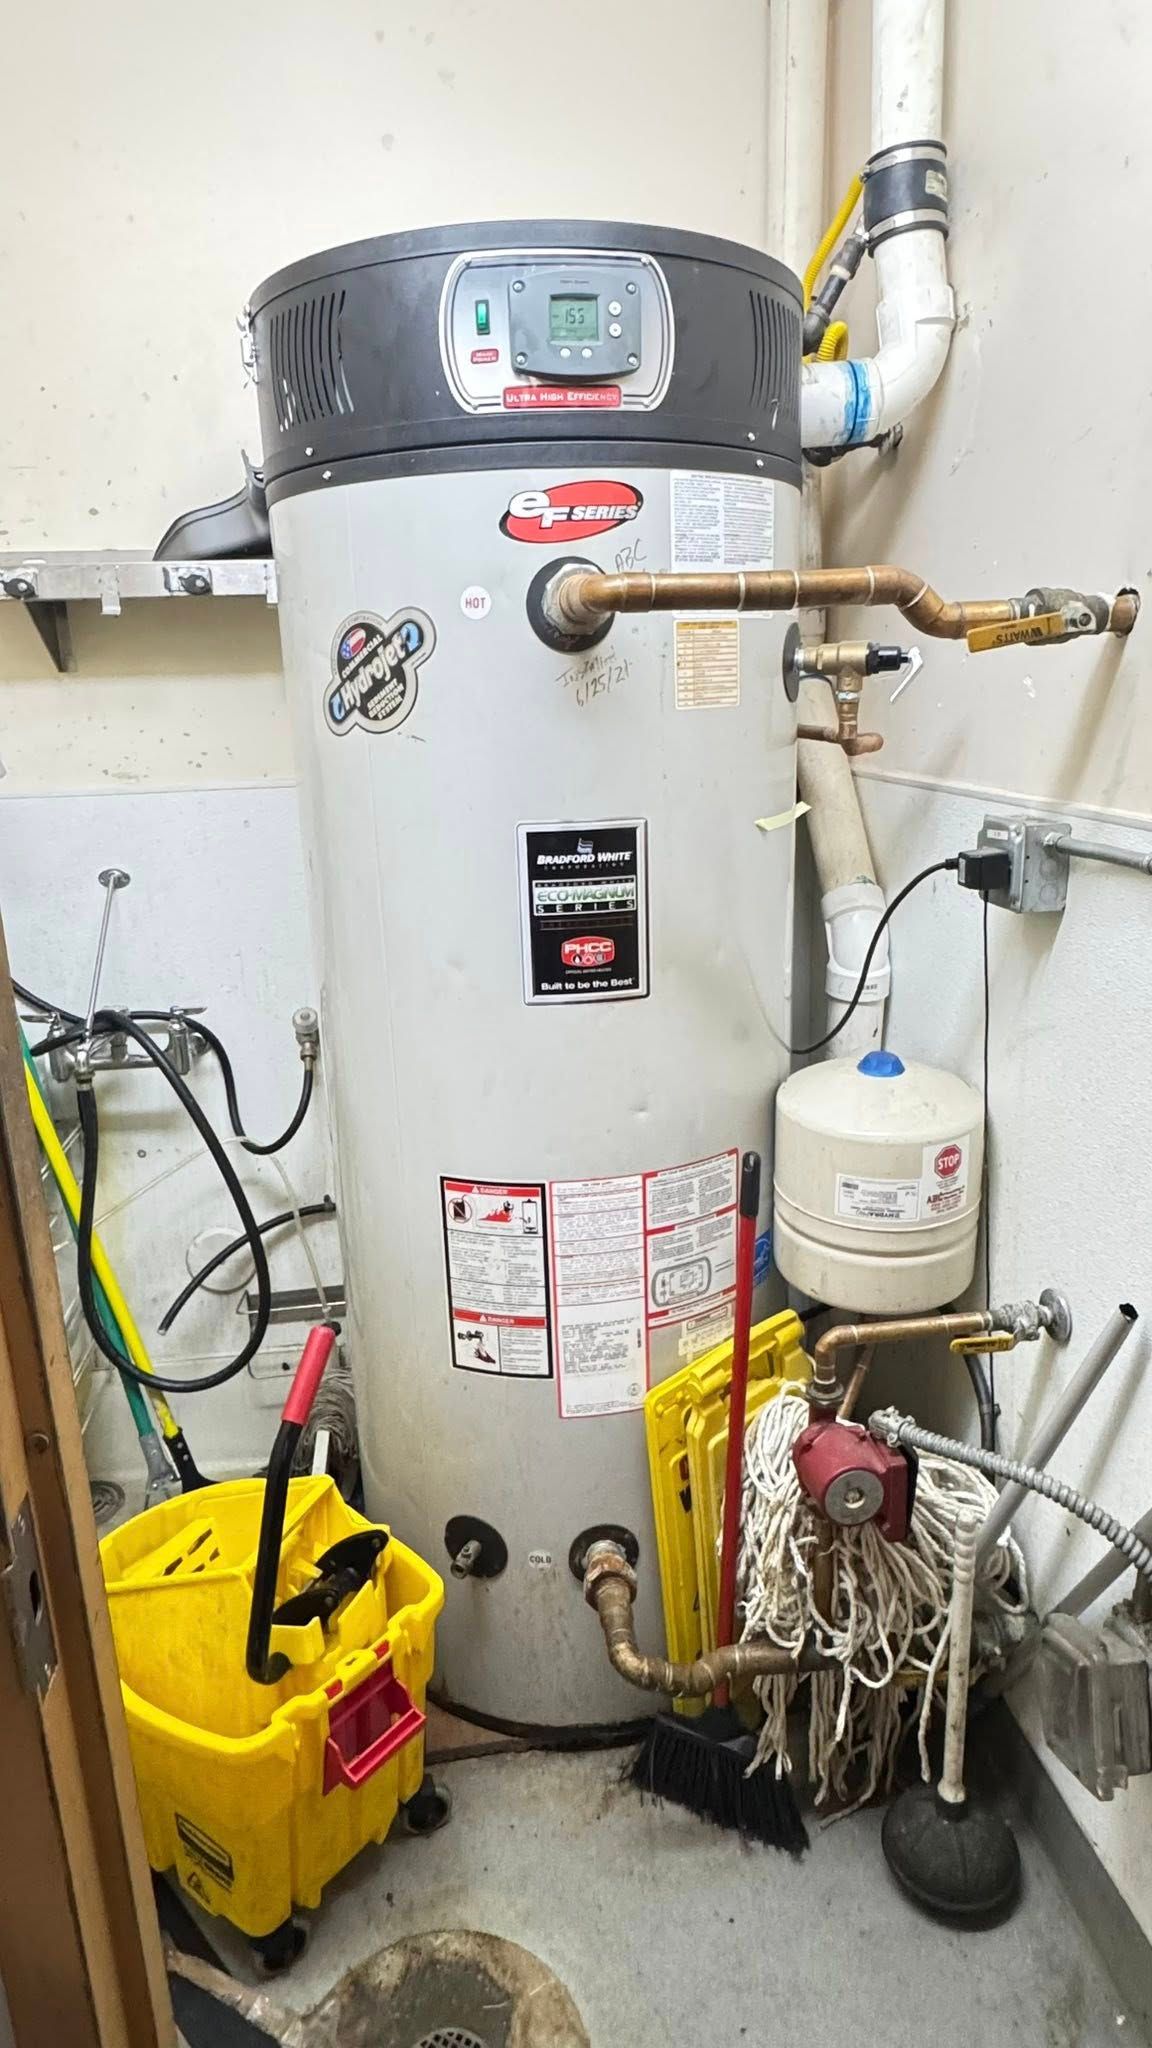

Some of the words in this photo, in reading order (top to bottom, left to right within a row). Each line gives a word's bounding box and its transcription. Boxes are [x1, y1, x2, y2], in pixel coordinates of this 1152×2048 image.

[564, 307, 585, 324] 155
[506, 392, 537, 403] ULTRA
[539, 392, 564, 401] HIGH
[567, 390, 619, 402] EFFICIENCY
[570, 504, 638, 521] SERIES
[464, 596, 487, 609] HOT
[341, 634, 384, 679] COMMERCIAL
[536, 853, 596, 865] BRADFORD
[597, 851, 633, 862] WHITE
[537, 901, 635, 914] SERIES
[564, 941, 613, 954] PHCC
[541, 981, 563, 990] Built
[564, 982, 576, 990] to
[577, 981, 591, 989] be
[592, 979, 609, 988] the
[610, 977, 633, 987] Best
[937, 1153, 960, 1170] STOP
[529, 1555, 552, 1564] COLD
